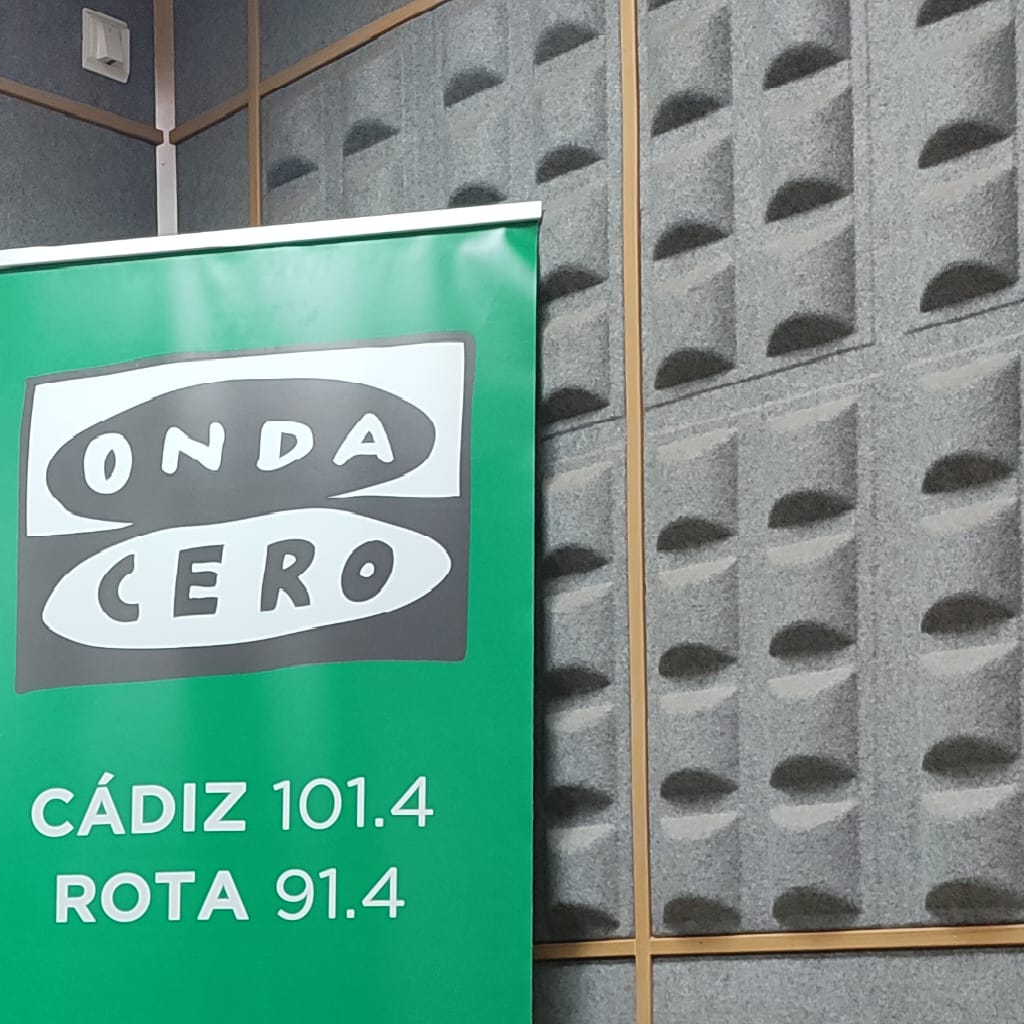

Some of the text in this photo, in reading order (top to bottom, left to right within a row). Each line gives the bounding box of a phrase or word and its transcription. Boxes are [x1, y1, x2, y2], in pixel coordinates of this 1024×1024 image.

[83, 413, 395, 494] ONDA
[98, 539, 394, 622] CERO
[31, 772, 434, 837] CÁDIZ 101.4
[56, 867, 405, 923] ROTA 91.4
